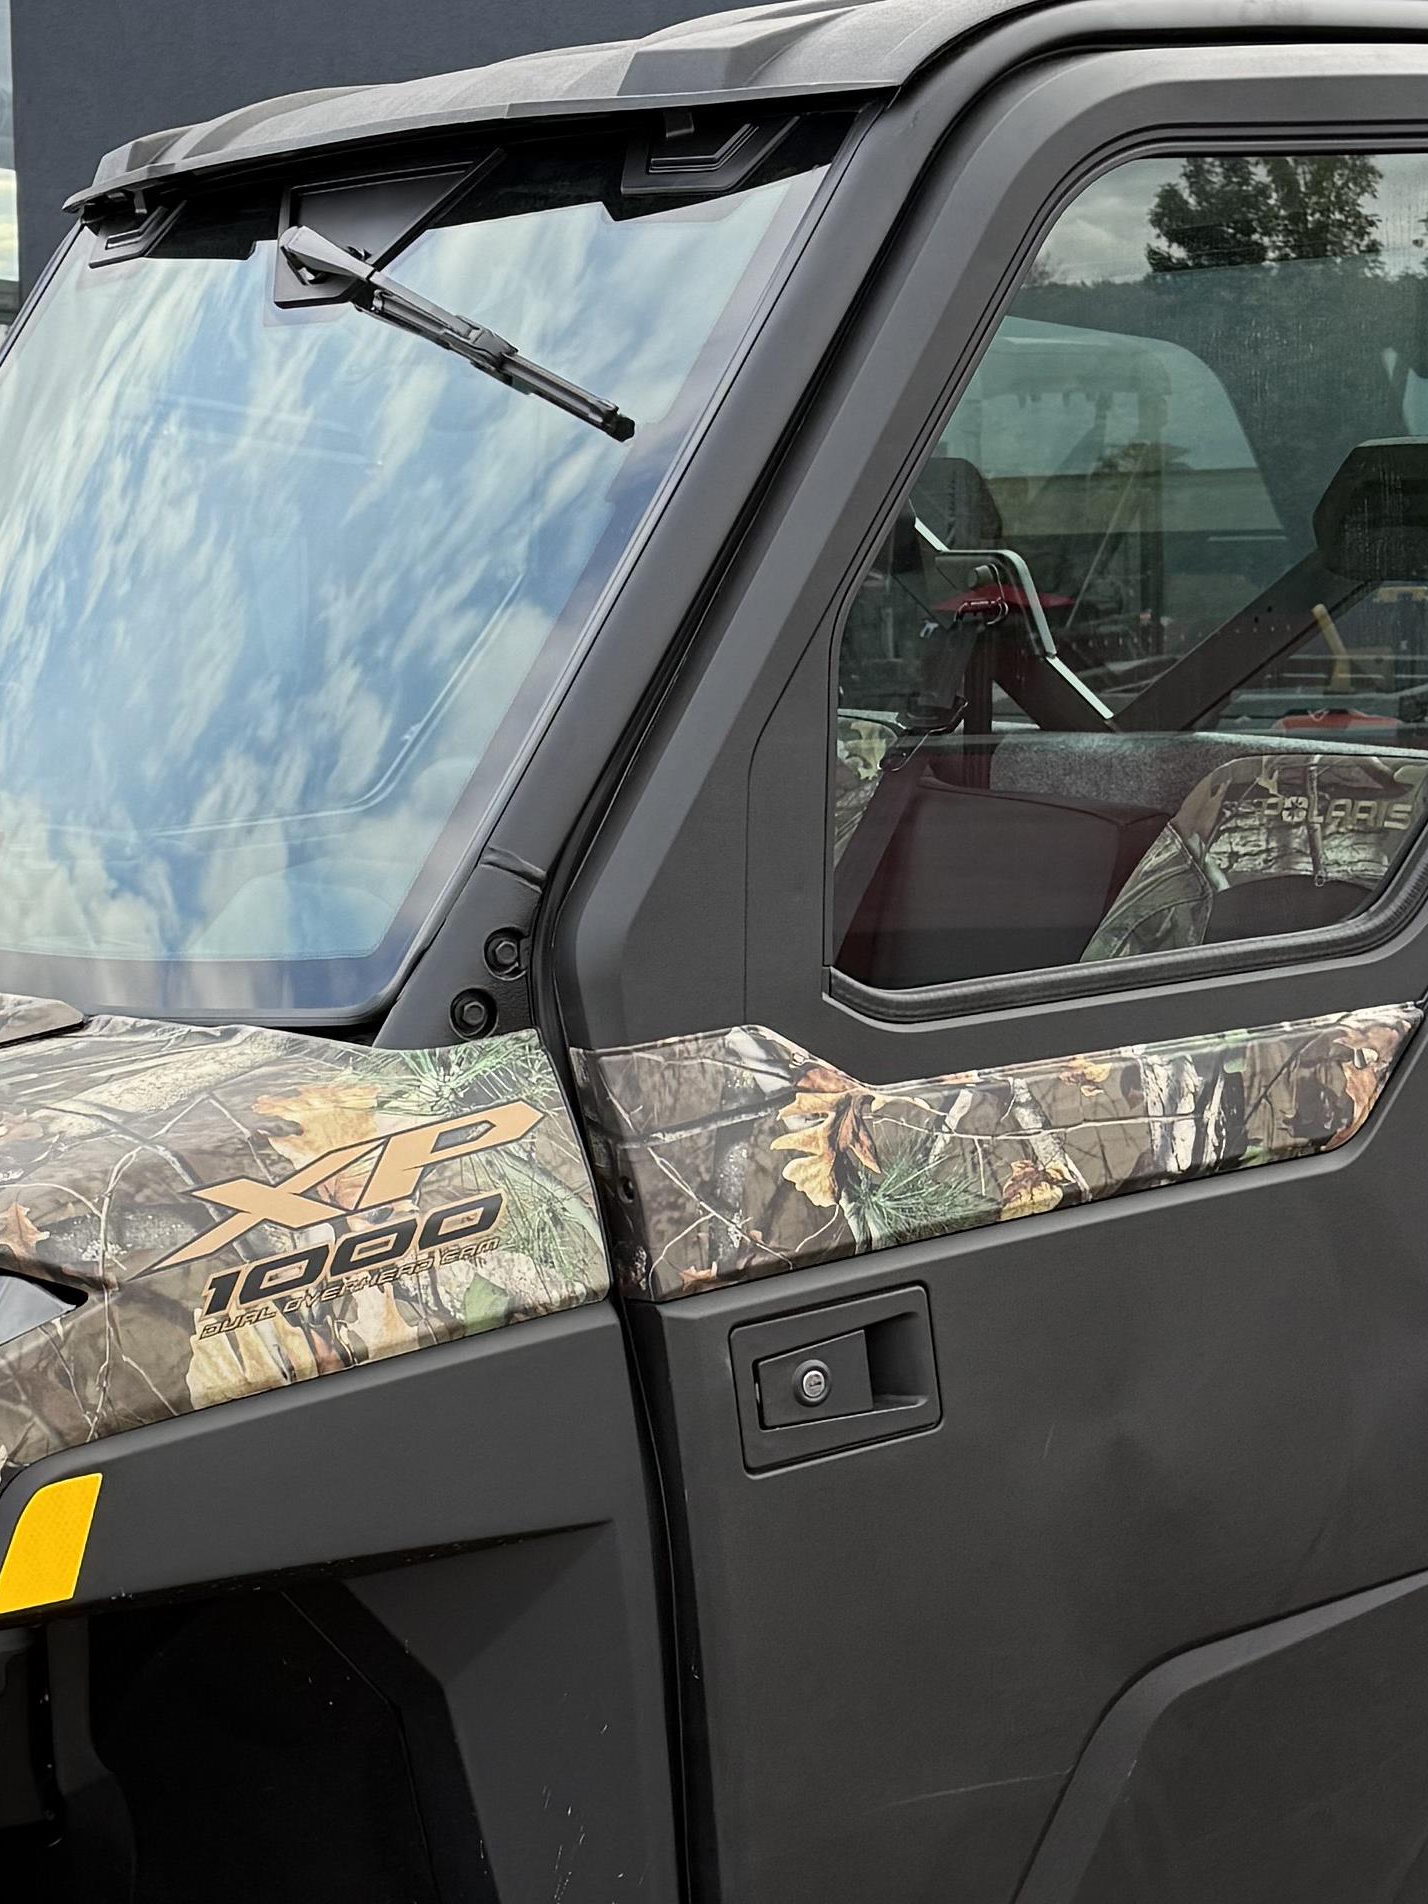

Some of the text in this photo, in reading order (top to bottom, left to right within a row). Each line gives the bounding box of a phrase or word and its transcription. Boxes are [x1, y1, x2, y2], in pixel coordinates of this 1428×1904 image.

[1261, 796, 1413, 830] POLARIS
[126, 1099, 546, 1282] XP
[198, 1191, 508, 1323] 1000
[199, 1235, 501, 1340] DUAL OVERHEAD CAM
